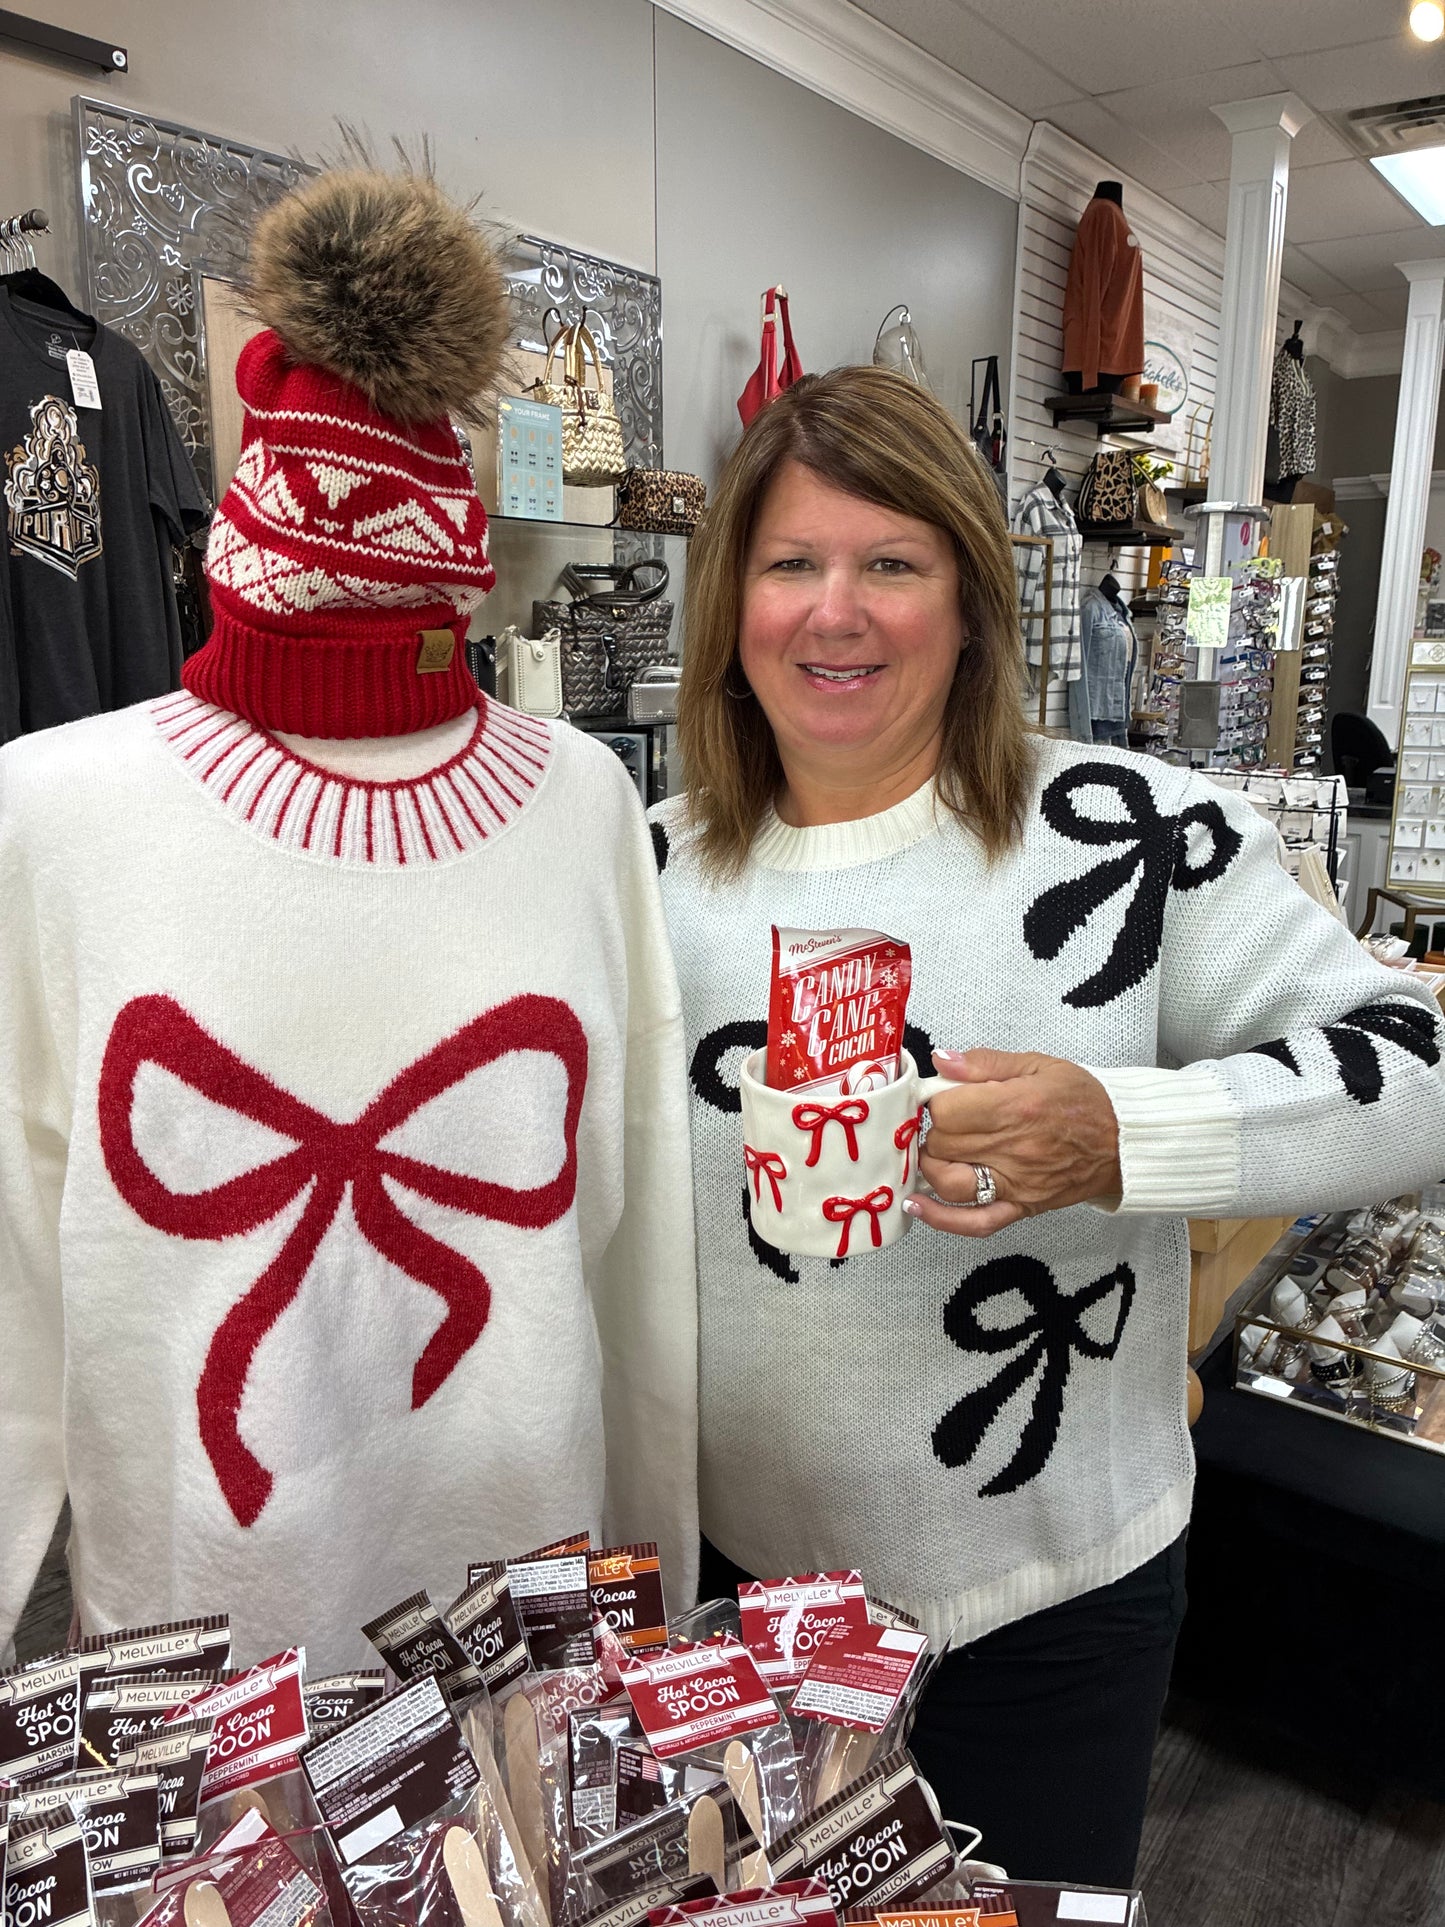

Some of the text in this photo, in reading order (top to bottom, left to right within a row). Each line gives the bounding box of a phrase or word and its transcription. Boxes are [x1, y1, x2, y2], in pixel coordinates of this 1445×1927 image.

[792, 952, 877, 1022] CANDY
[807, 991, 880, 1057] CANE
[829, 1030, 875, 1065] COCOA
[592, 1589, 637, 1604] Cocoa
[473, 1617, 502, 1642] Cocoa
[118, 1639, 184, 1661] MELVILLE
[400, 1638, 444, 1667] Hot Cocoa
[656, 1654, 710, 1675] MELVILLE
[22, 1666, 78, 1692] MELVILL
[657, 1675, 736, 1703] Hot Cocoa
[126, 1690, 191, 1703] MELVILLE
[201, 1681, 259, 1717] MELVILLE
[668, 1685, 740, 1719] SPOON
[16, 1702, 54, 1727] Hot
[108, 1718, 144, 1736] Hot
[227, 1704, 276, 1731] Cocoa
[690, 1712, 737, 1732] PEPPERMINT
[140, 1742, 181, 1761] MELVILLE
[208, 1753, 260, 1782] PEPPERMINT
[809, 1796, 872, 1849] MELVILLE
[814, 1819, 903, 1880] Hot Cocoa
[828, 1836, 907, 1907] SPOON
